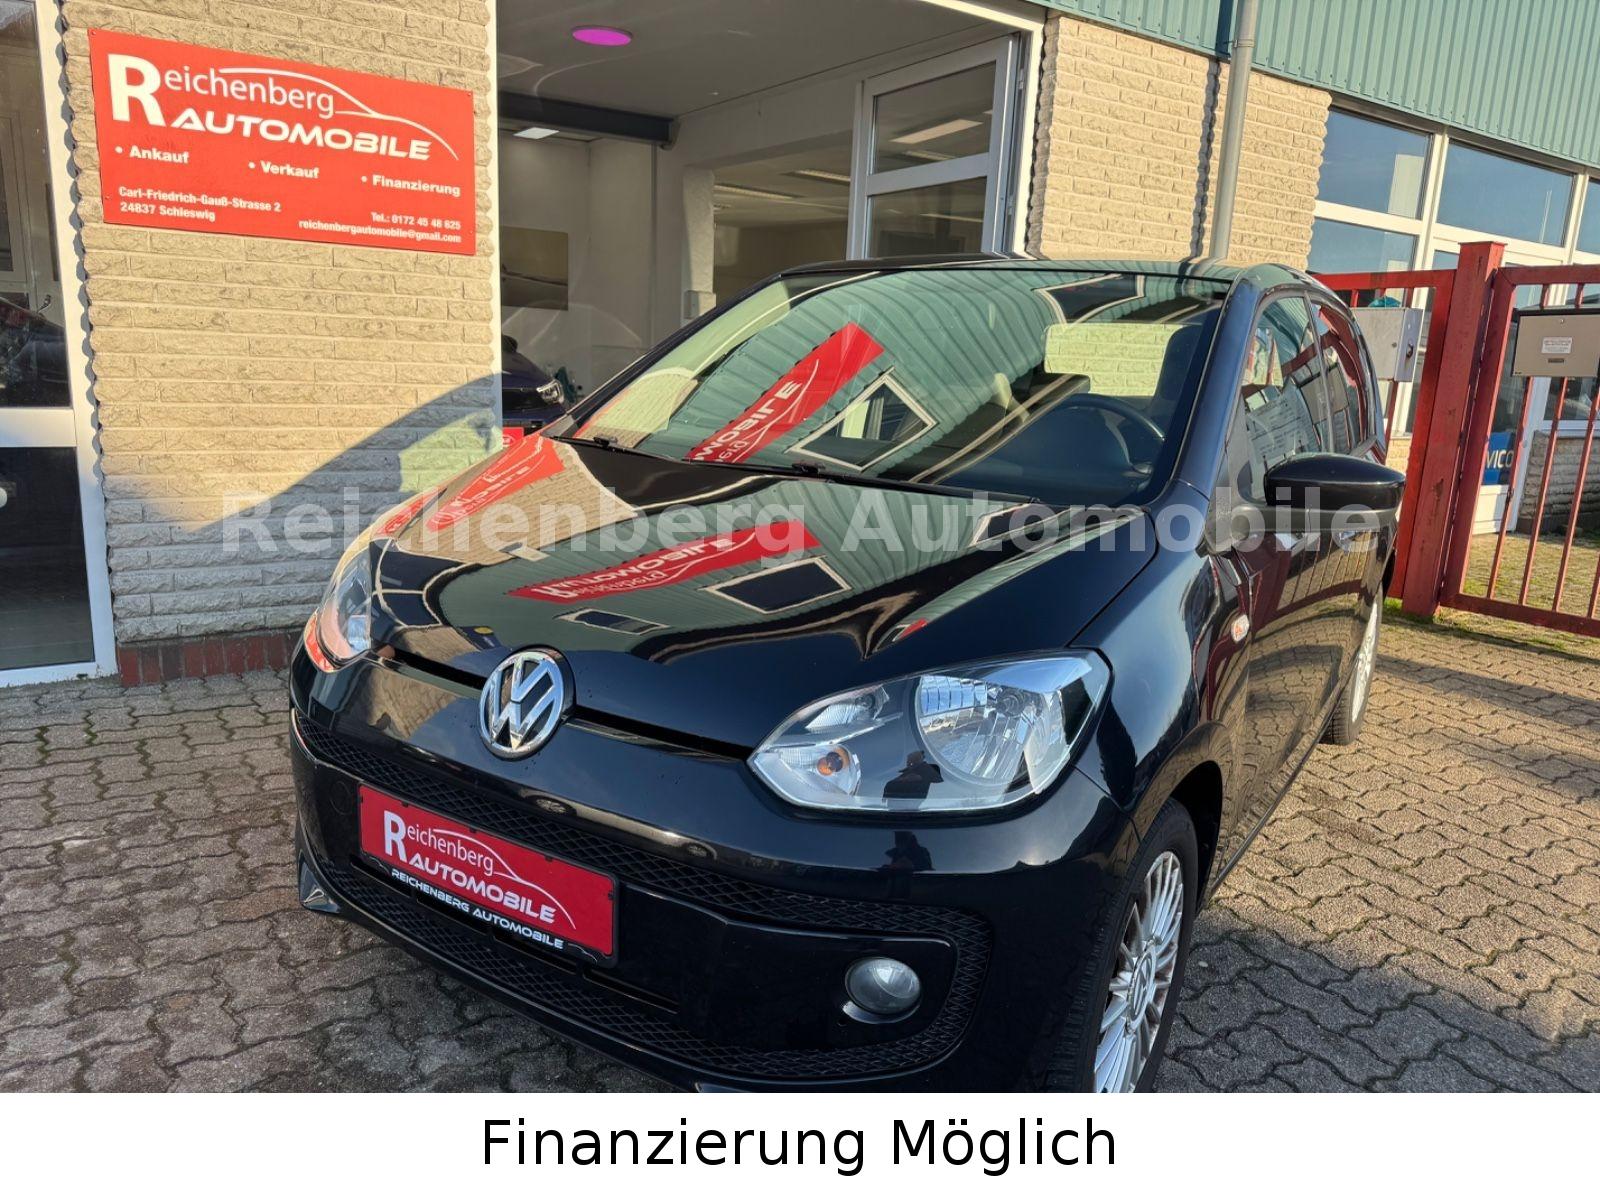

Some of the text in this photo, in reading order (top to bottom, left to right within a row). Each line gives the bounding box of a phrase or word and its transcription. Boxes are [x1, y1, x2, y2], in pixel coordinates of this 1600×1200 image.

[107, 53, 335, 128] Reichenberg
[171, 107, 433, 161] AUTOMOBILE
[129, 144, 190, 165] Ankauf
[260, 160, 320, 180] Verkauf
[118, 185, 282, 213] Carl-Friedrich-Gauß-Strasse 2
[372, 174, 461, 198] Finanzierung
[120, 201, 216, 222] 24837 Schleswig
[370, 211, 390, 223] Tel.:
[391, 214, 415, 226] 0172
[417, 217, 429, 228] 45
[298, 218, 462, 244] reichenbergautomobile@gmail.com
[384, 810, 494, 877] Reichenberg
[408, 853, 557, 924] AUTOMOBILE
[391, 868, 564, 950] REICHENBERG AUTOMOBILE
